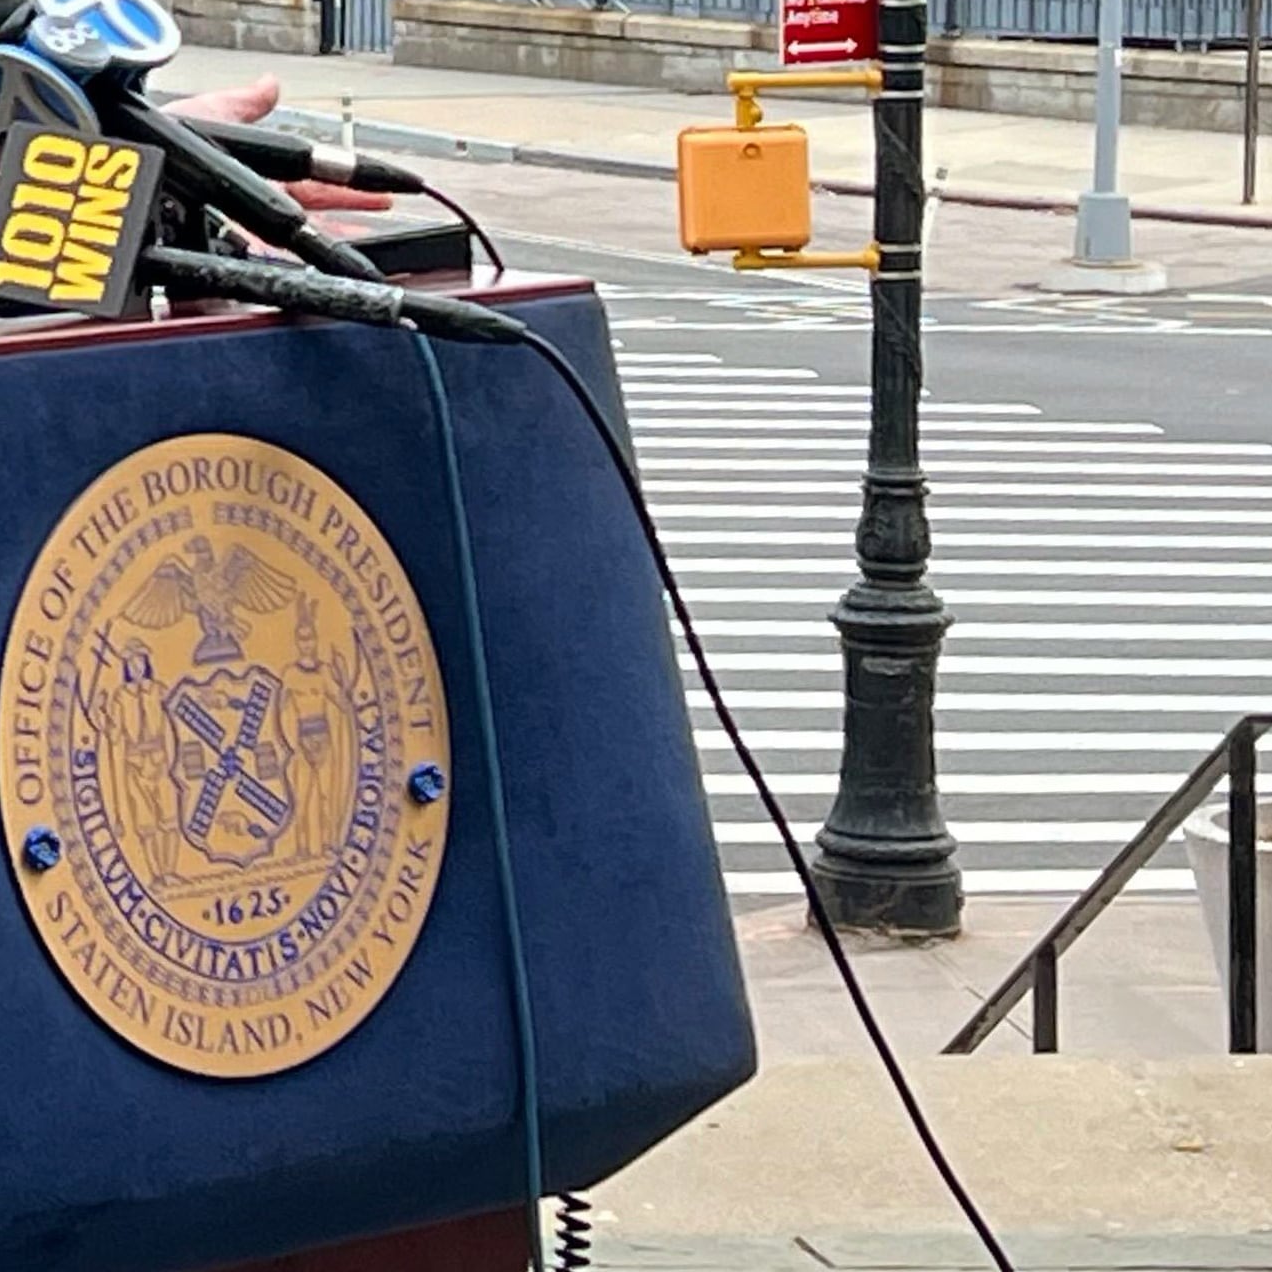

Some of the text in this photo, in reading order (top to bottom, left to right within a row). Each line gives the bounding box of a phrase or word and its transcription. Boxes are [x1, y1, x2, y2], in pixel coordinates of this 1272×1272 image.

[49, 143, 141, 302] WINS
[14, 456, 435, 805] OFFICE OF THE BOROUGH PRESIDENT
[45, 890, 155, 1027] STATEN
[305, 948, 377, 1025] NEW
[372, 835, 434, 947] YORK
[144, 913, 300, 978] CIVITATIS
[299, 859, 363, 942] NOVI
[214, 886, 283, 926] 1625
